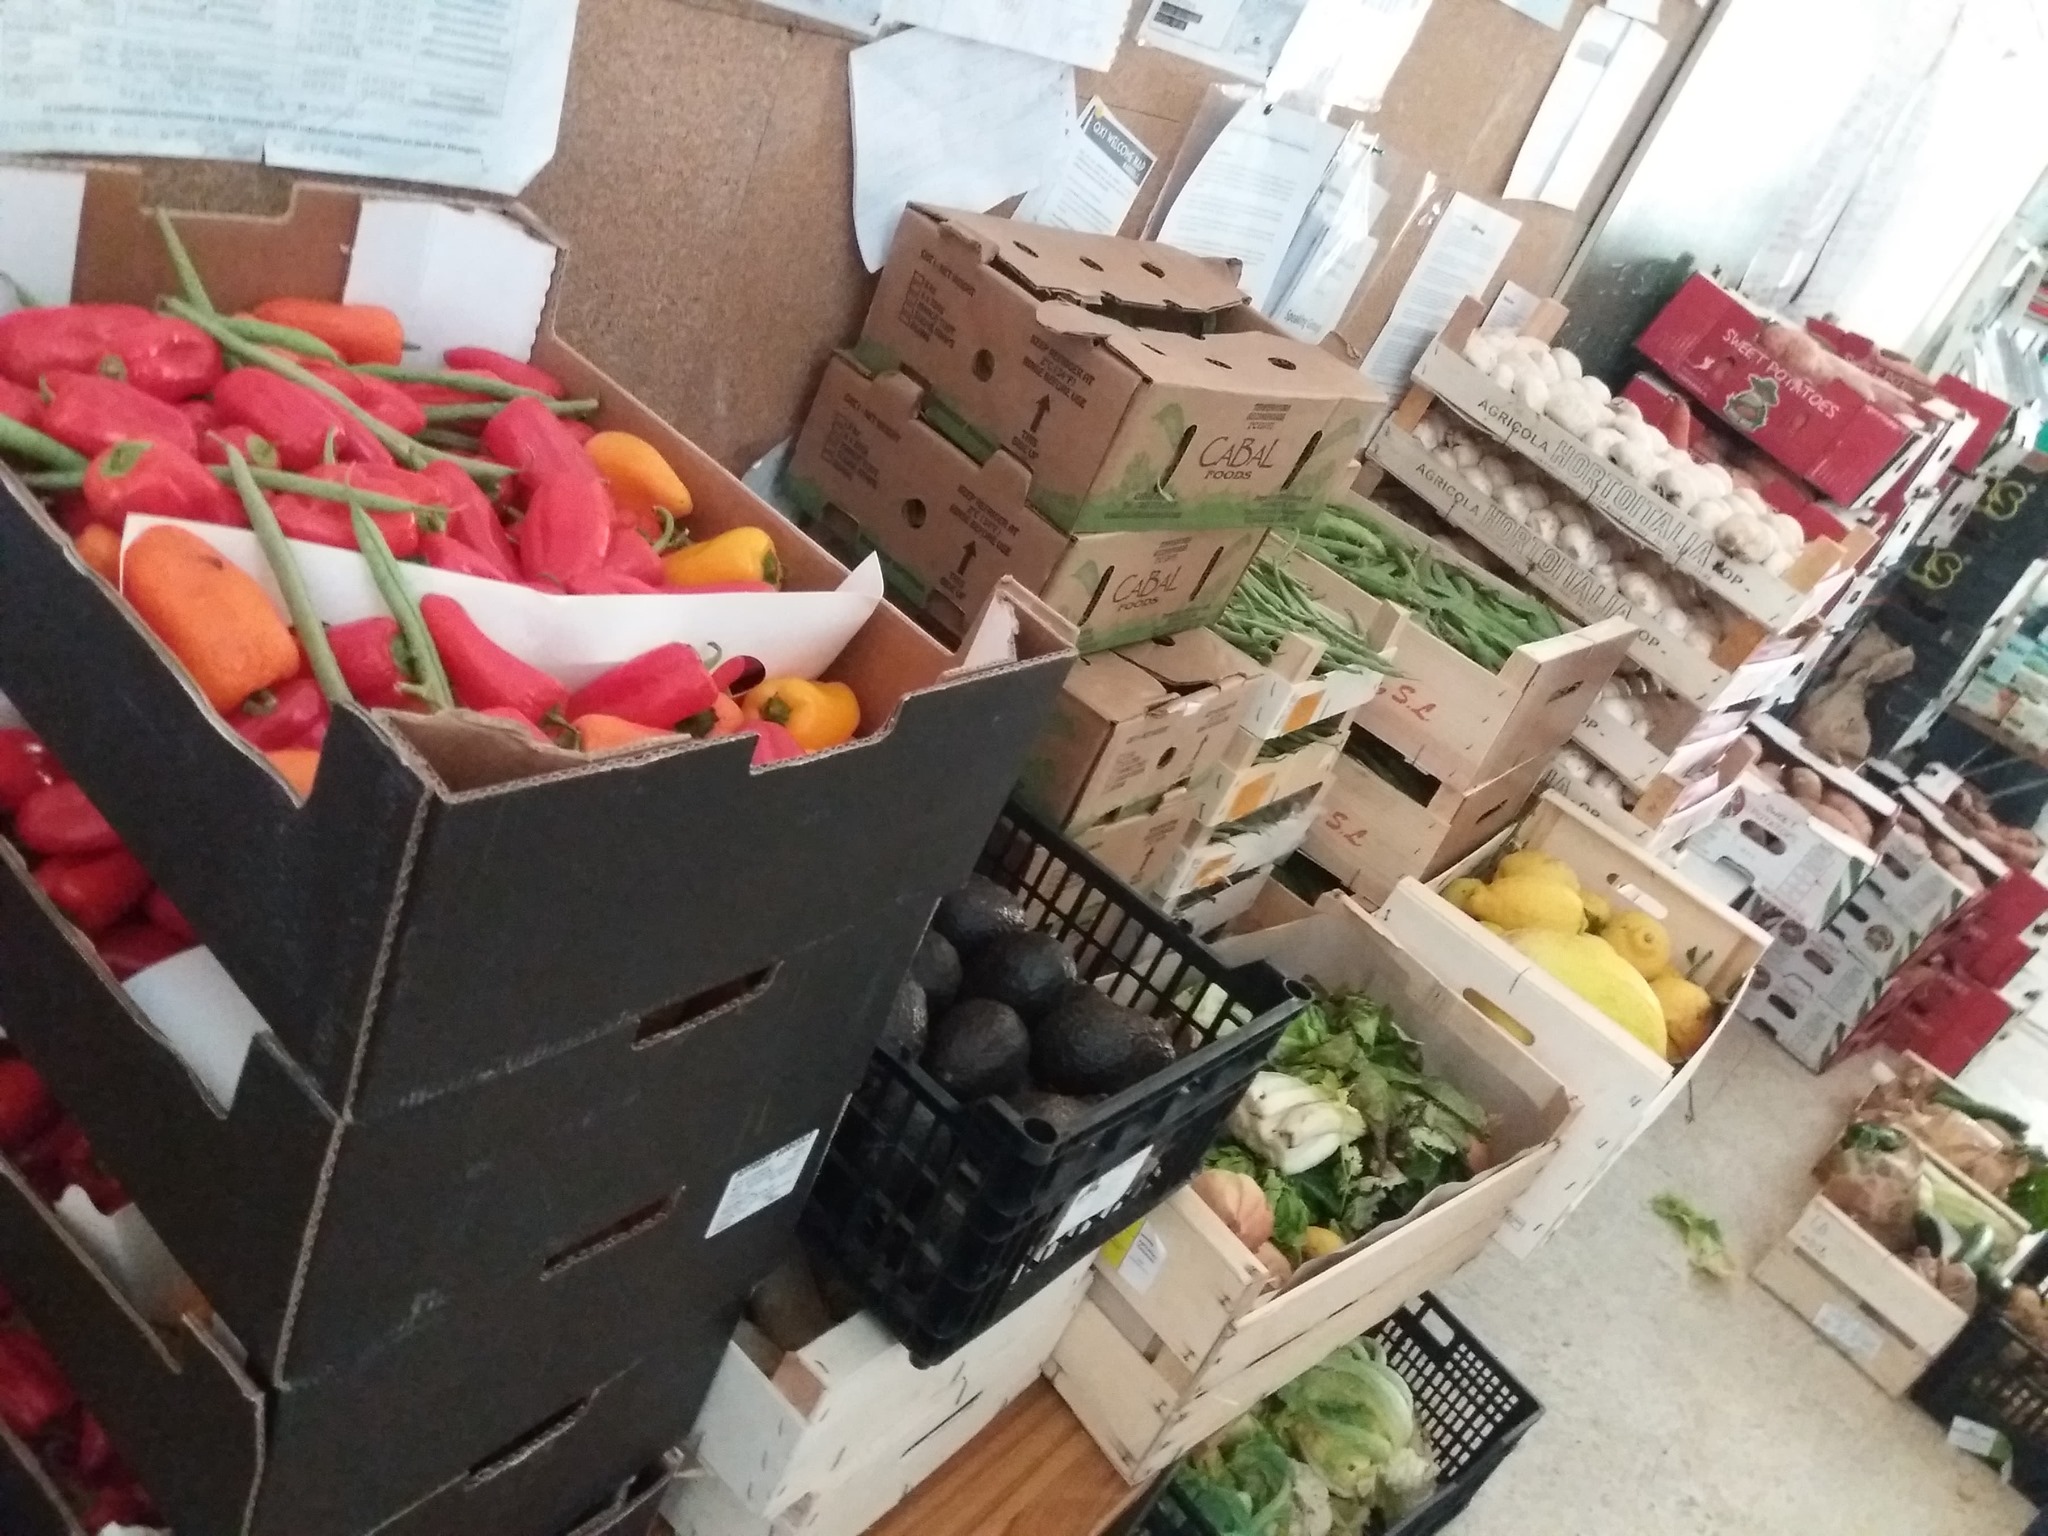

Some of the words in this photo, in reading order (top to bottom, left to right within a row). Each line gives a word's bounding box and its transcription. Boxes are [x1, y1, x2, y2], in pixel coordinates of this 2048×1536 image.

[1721, 328, 1770, 364] SWEET
[1766, 361, 1840, 420] POTATOES
[1204, 470, 1253, 480] FOODS
[1477, 399, 1549, 453] AGRICOLA
[1549, 439, 1715, 569] HORTOITALIA
[1416, 462, 1479, 517] AGRICOLA
[1480, 503, 1633, 620] HORTOITALIA
[1118, 596, 1159, 611] FOODS
